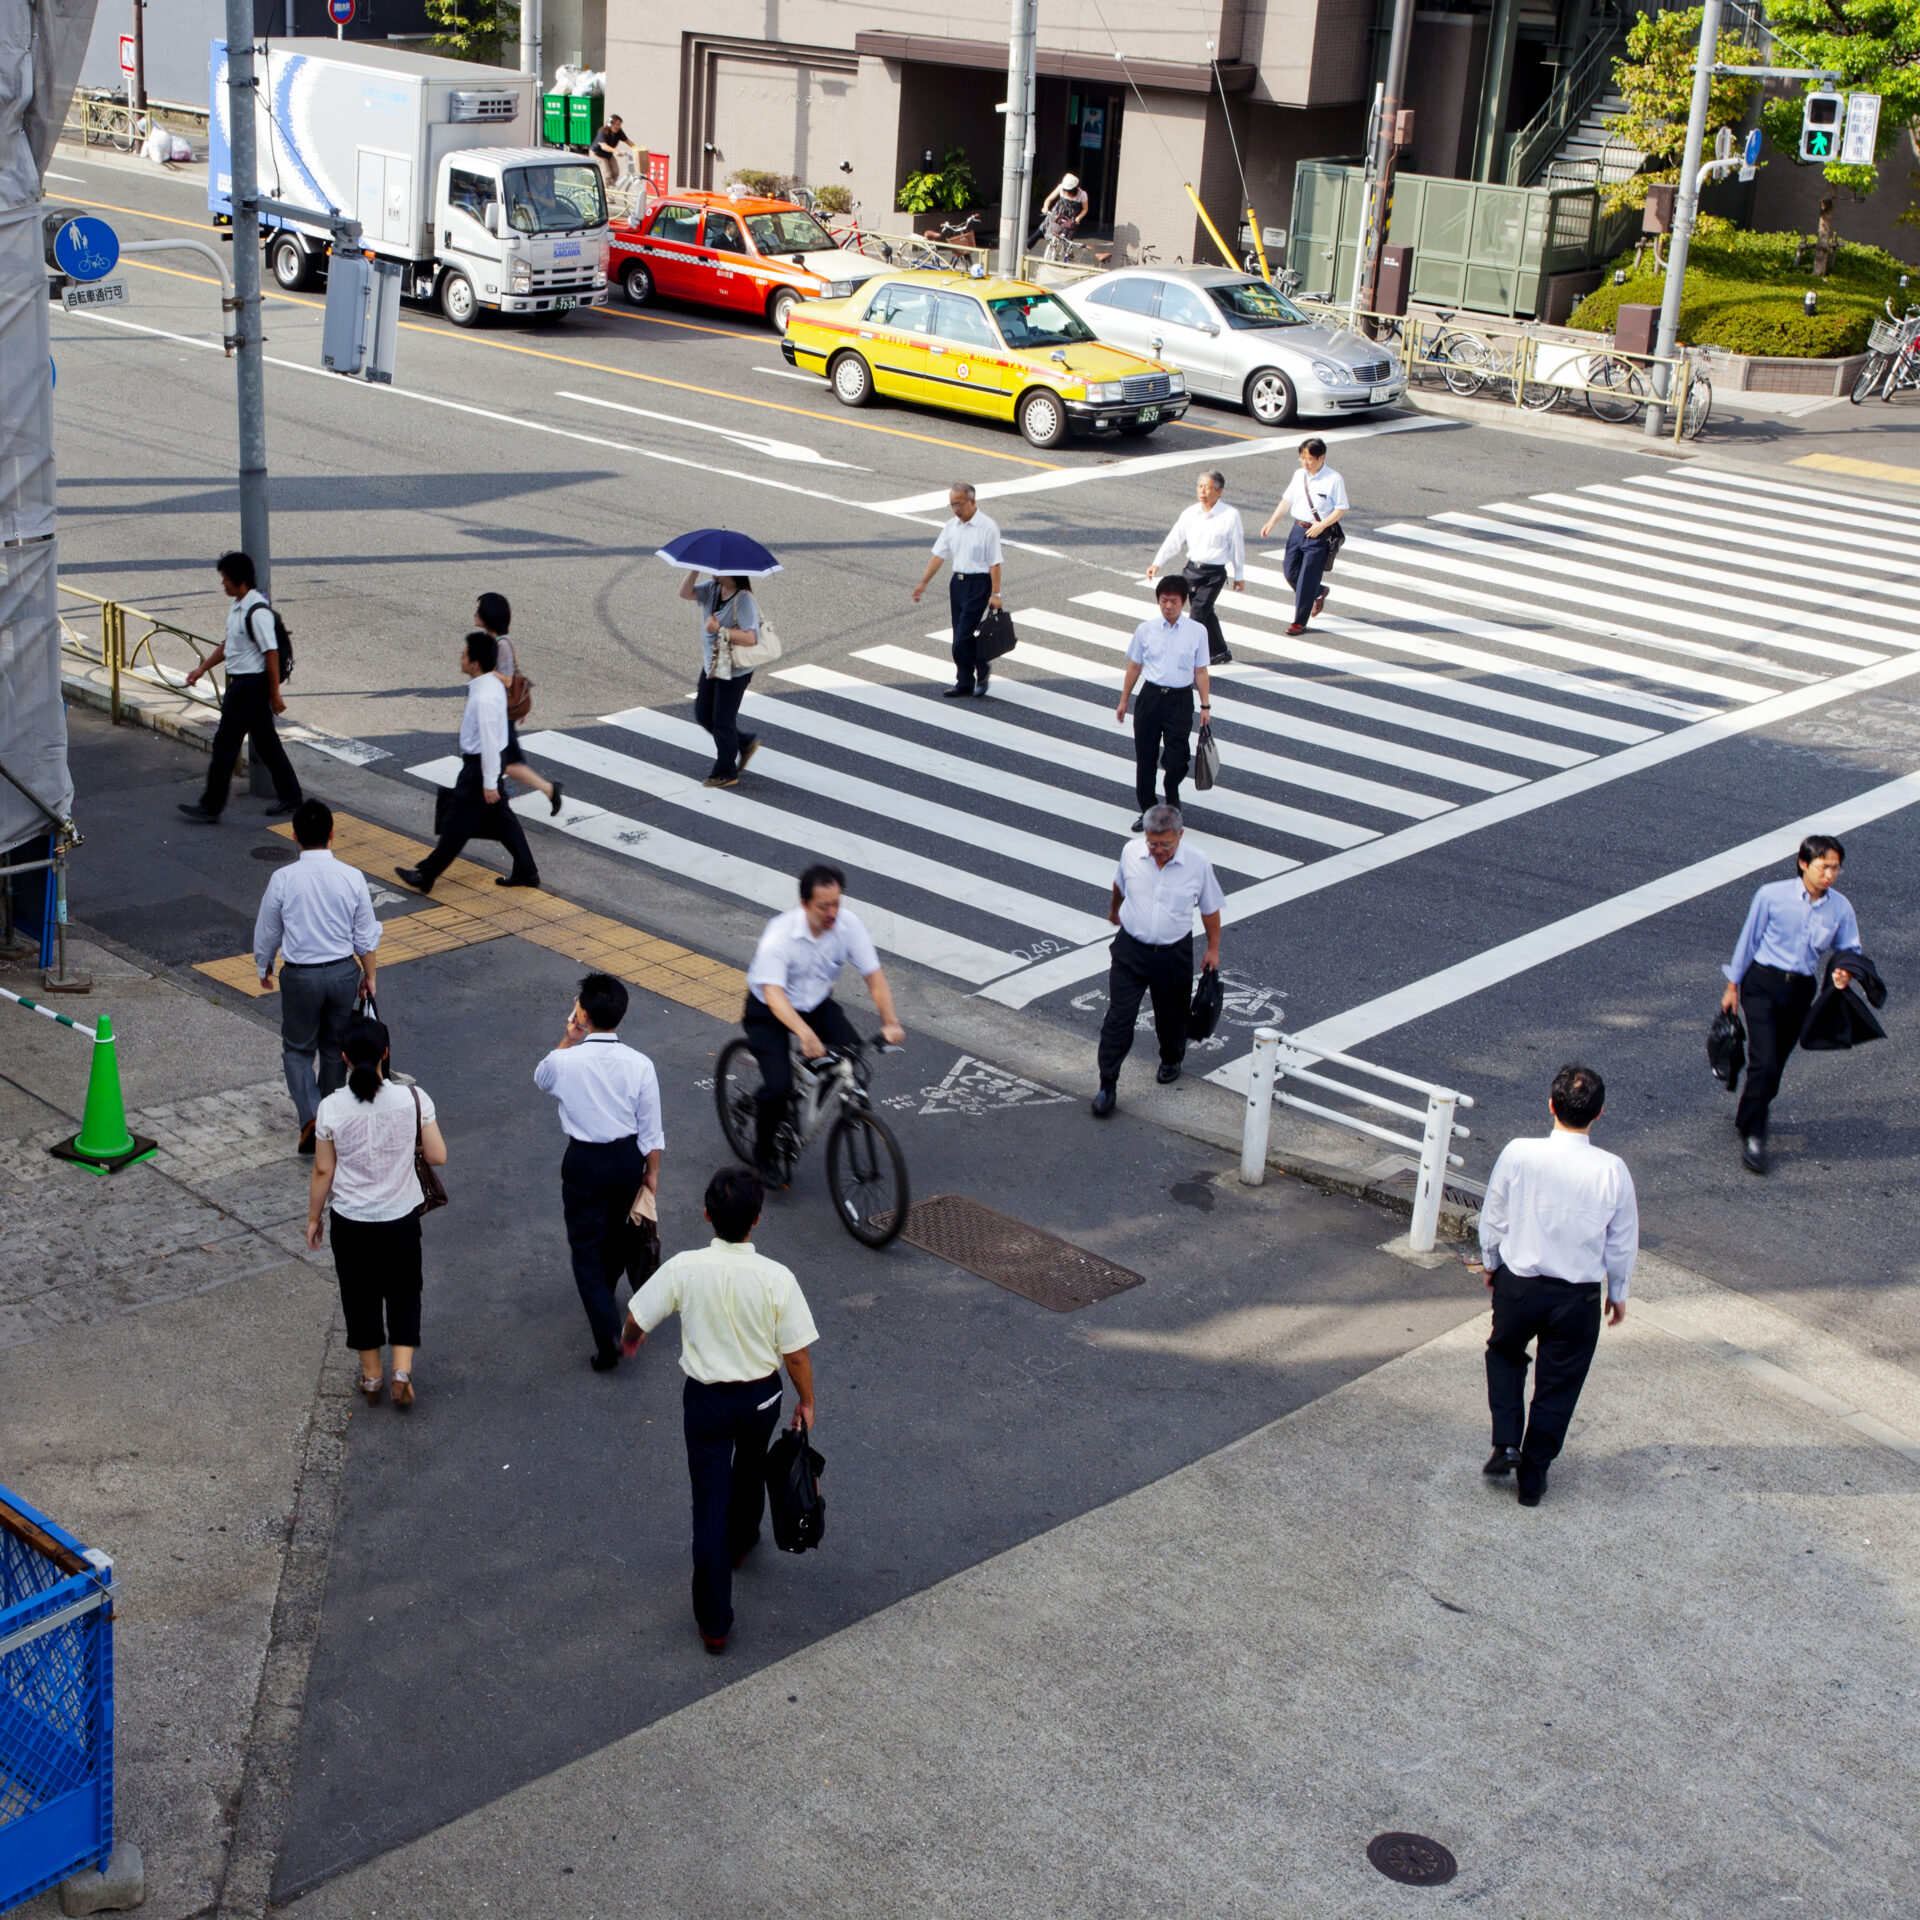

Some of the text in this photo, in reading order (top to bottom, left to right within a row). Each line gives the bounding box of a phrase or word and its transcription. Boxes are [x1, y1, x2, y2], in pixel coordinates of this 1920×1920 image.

[553, 249, 581, 258] SAGAWA
[67, 285, 123, 307] 自転車通行可
[560, 301, 576, 310] 73-39
[948, 349, 971, 359] NIHON
[1008, 362, 1031, 372] TAXI
[1011, 940, 1070, 961] 242
